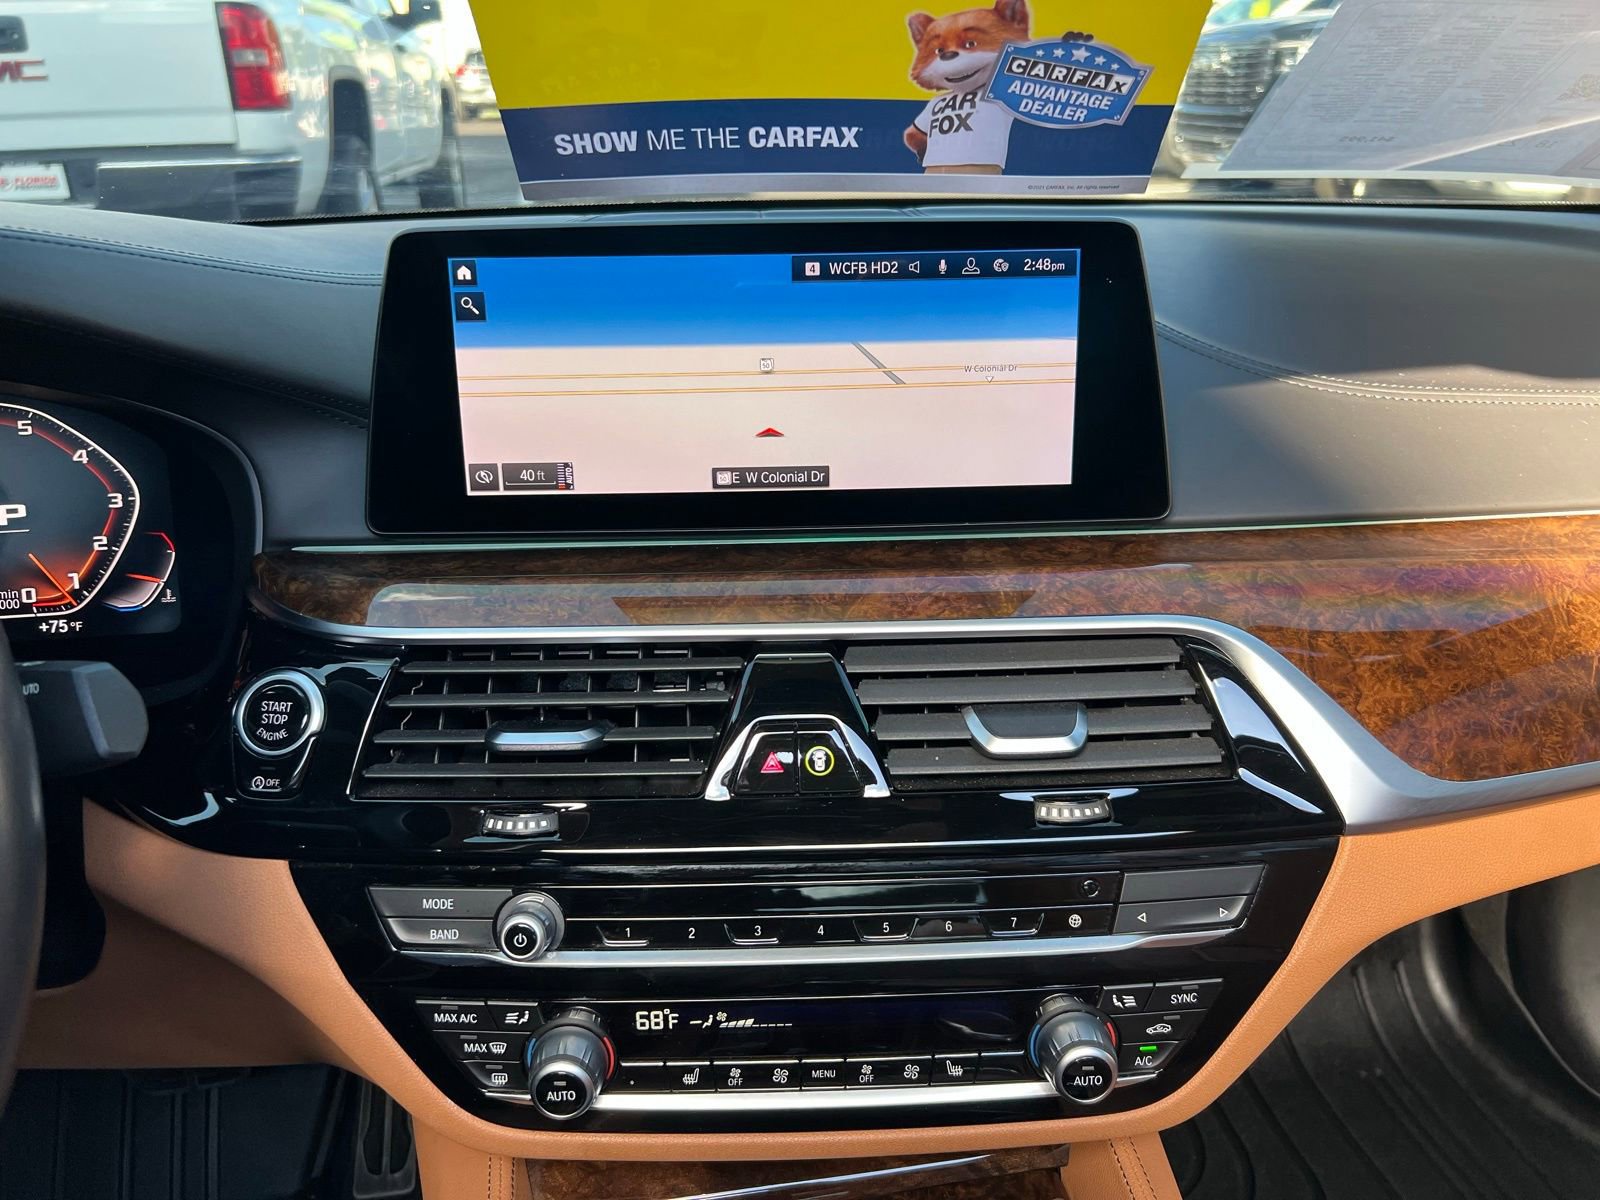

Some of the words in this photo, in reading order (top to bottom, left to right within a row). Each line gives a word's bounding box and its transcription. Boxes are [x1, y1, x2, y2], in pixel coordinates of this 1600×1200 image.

[0, 60, 49, 82] MC
[1009, 58, 1129, 94] CARFAX
[1008, 80, 1114, 110] ADVANTAGE
[931, 91, 977, 117] CAR
[1019, 99, 1088, 122] DEALER
[929, 112, 974, 138] FOX
[554, 131, 638, 155] SHOW
[647, 128, 686, 150] ME
[691, 127, 741, 149] THE
[829, 261, 868, 275] WCFB
[871, 260, 899, 274] HD2
[1023, 258, 1065, 272] 2:48pm
[964, 365, 973, 373] W
[974, 364, 1007, 373] Colonial
[1008, 363, 1017, 372] Dr
[17, 420, 33, 435] 5
[72, 449, 89, 464] 4
[520, 469, 535, 481] 40
[536, 469, 546, 481] ft
[565, 467, 573, 484] AUTO
[732, 471, 741, 484] E
[745, 471, 759, 484] W
[761, 470, 808, 484] Colonial
[811, 470, 826, 482] Dr
[107, 493, 123, 508] 3
[0, 504, 27, 526] P
[92, 535, 109, 551] 2
[67, 572, 80, 590] 1
[21, 587, 37, 603] 0
[22, 682, 40, 695] UTO
[261, 701, 293, 713] START
[261, 713, 289, 725] STOP
[256, 727, 289, 741] ENGINE
[266, 778, 281, 787] OFF
[422, 898, 454, 910] MODE
[429, 929, 460, 941] BAND
[624, 927, 631, 938] 1
[688, 928, 696, 939] 2
[753, 925, 762, 937] 3
[817, 924, 825, 936] 4
[882, 921, 890, 933] 5
[945, 920, 953, 932] 6
[1010, 917, 1018, 929] 7
[1170, 992, 1199, 1004] SYNC
[434, 1012, 458, 1024] MAX
[459, 1012, 478, 1025] A/C
[464, 1042, 488, 1054] MAX
[1134, 1055, 1153, 1067] A/C
[811, 1069, 837, 1079] MENU
[859, 1073, 875, 1084] OFF
[1073, 1074, 1103, 1087] AUTO
[728, 1076, 744, 1087] OFF
[546, 1090, 577, 1103] AUTO
